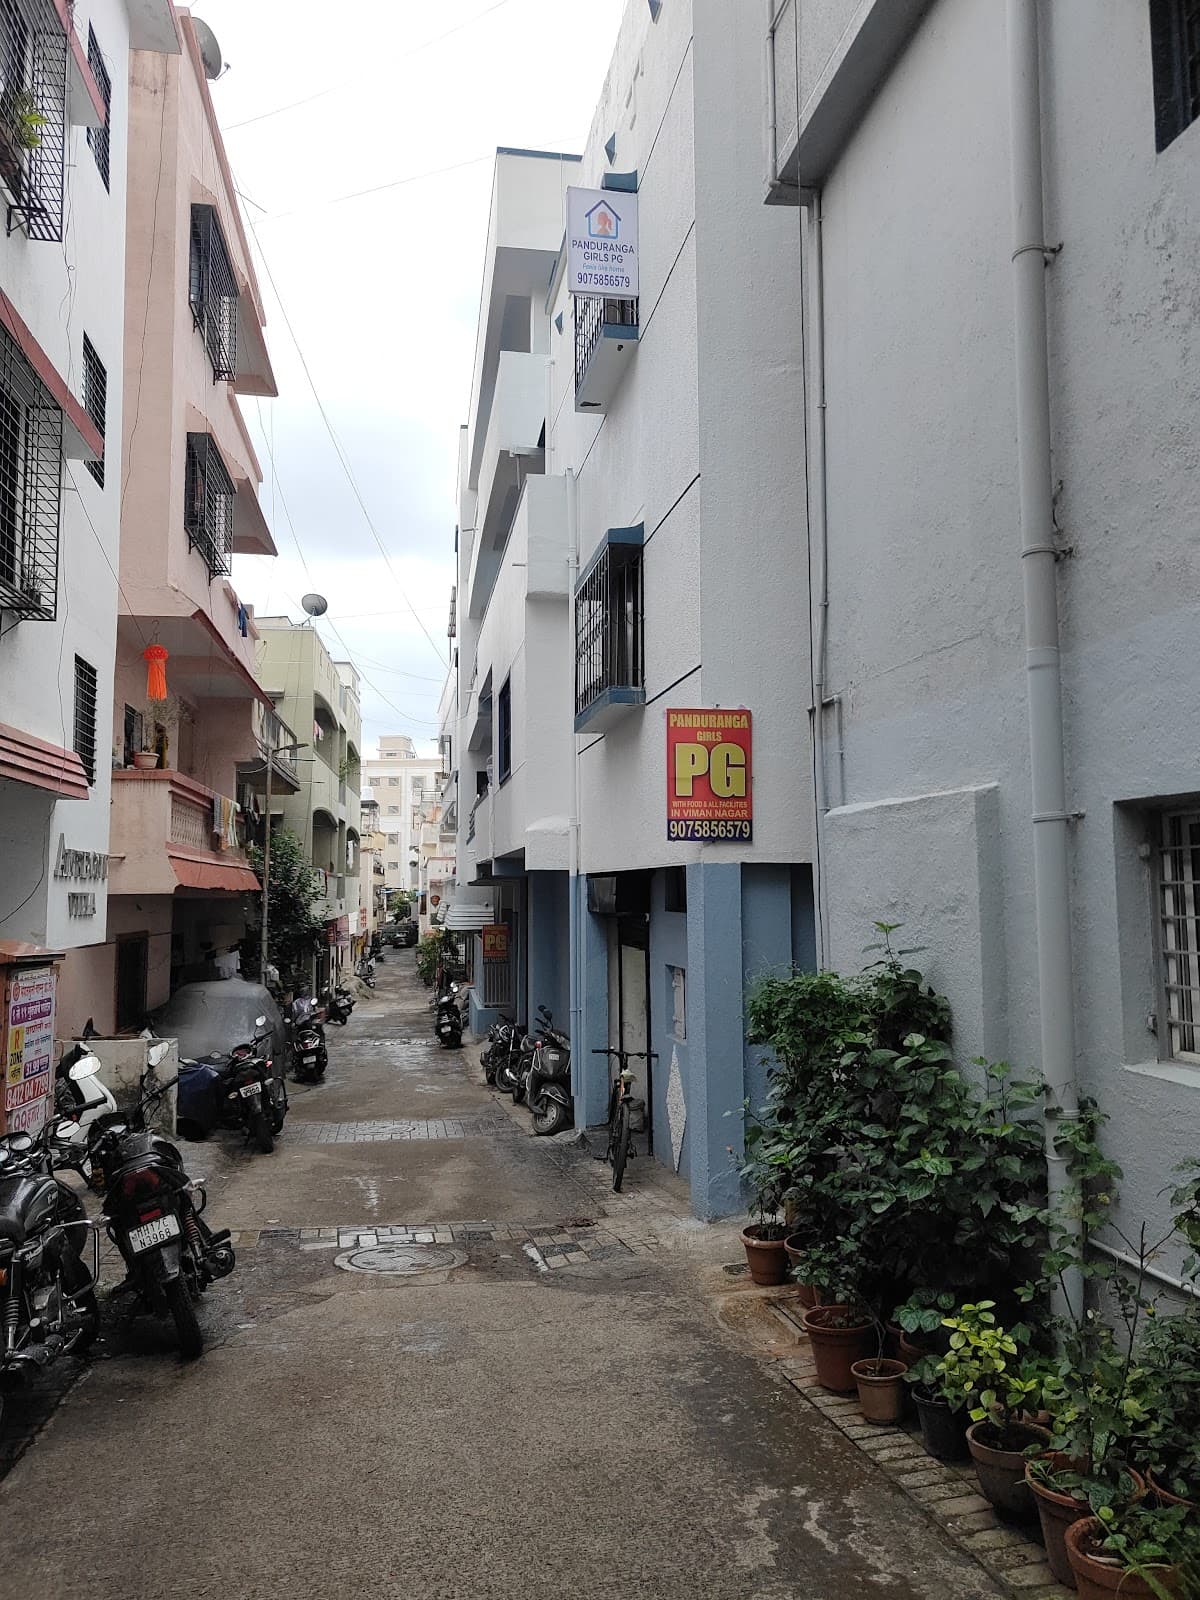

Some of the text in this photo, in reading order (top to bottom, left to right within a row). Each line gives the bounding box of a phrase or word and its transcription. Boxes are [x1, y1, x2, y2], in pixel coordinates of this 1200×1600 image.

[572, 240, 635, 254] PANDURANGA
[583, 252, 624, 264] GIRLS PG
[577, 272, 630, 288] 9075856579
[669, 713, 749, 729] PANDURANGA
[696, 730, 722, 742] GIRLS
[675, 742, 746, 798] PG
[671, 809, 748, 818] IN VIMAN NAGAR
[669, 820, 750, 838] 9075856579
[484, 934, 507, 951] PG
[14, 1030, 20, 1049] R
[9, 1051, 23, 1067] ZONE
[139, 1227, 171, 1249] N3968
